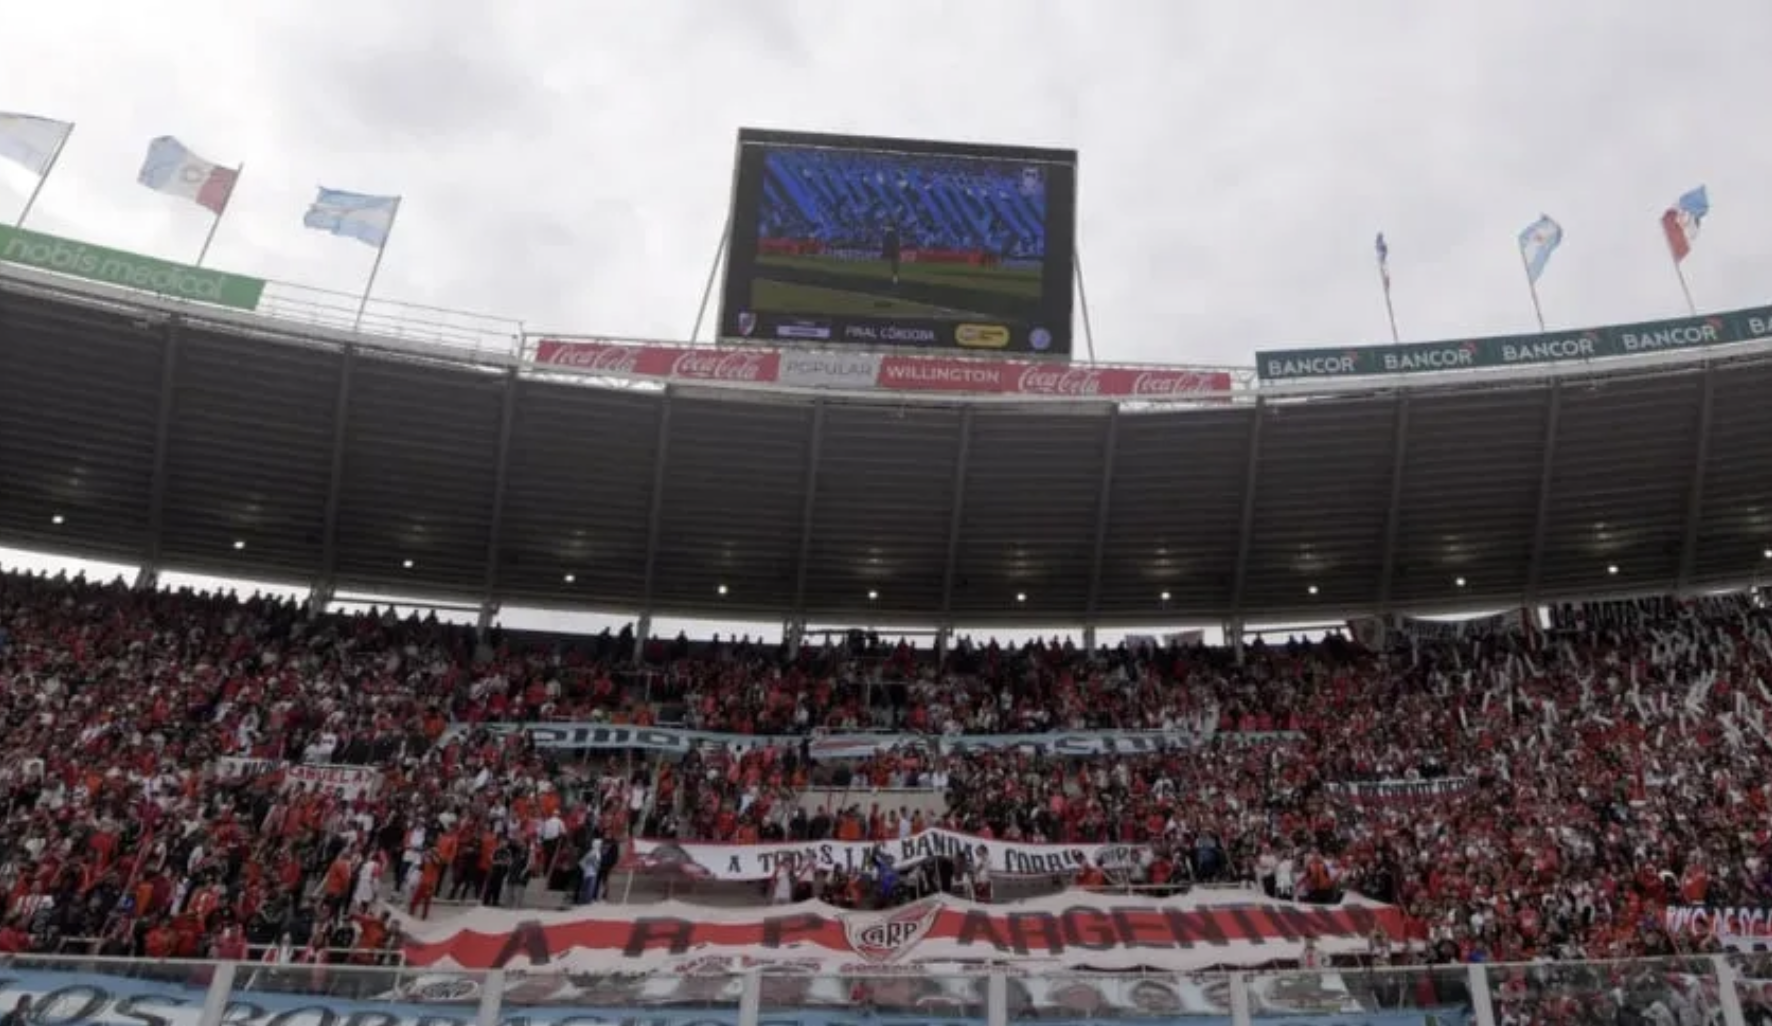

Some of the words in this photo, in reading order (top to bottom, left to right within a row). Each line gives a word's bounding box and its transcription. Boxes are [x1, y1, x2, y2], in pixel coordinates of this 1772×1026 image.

[6, 237, 97, 274] nobis
[102, 257, 223, 299] medical
[1622, 325, 1718, 351] BANCOR
[1383, 350, 1473, 371] BANCOR
[1502, 338, 1595, 362] BANCOR
[787, 361, 873, 378] POPULAR
[886, 364, 1000, 383] WILLINGTON
[1267, 357, 1355, 377] BANCOR
[729, 854, 741, 874] A
[956, 902, 1384, 955] ARGENTINA
